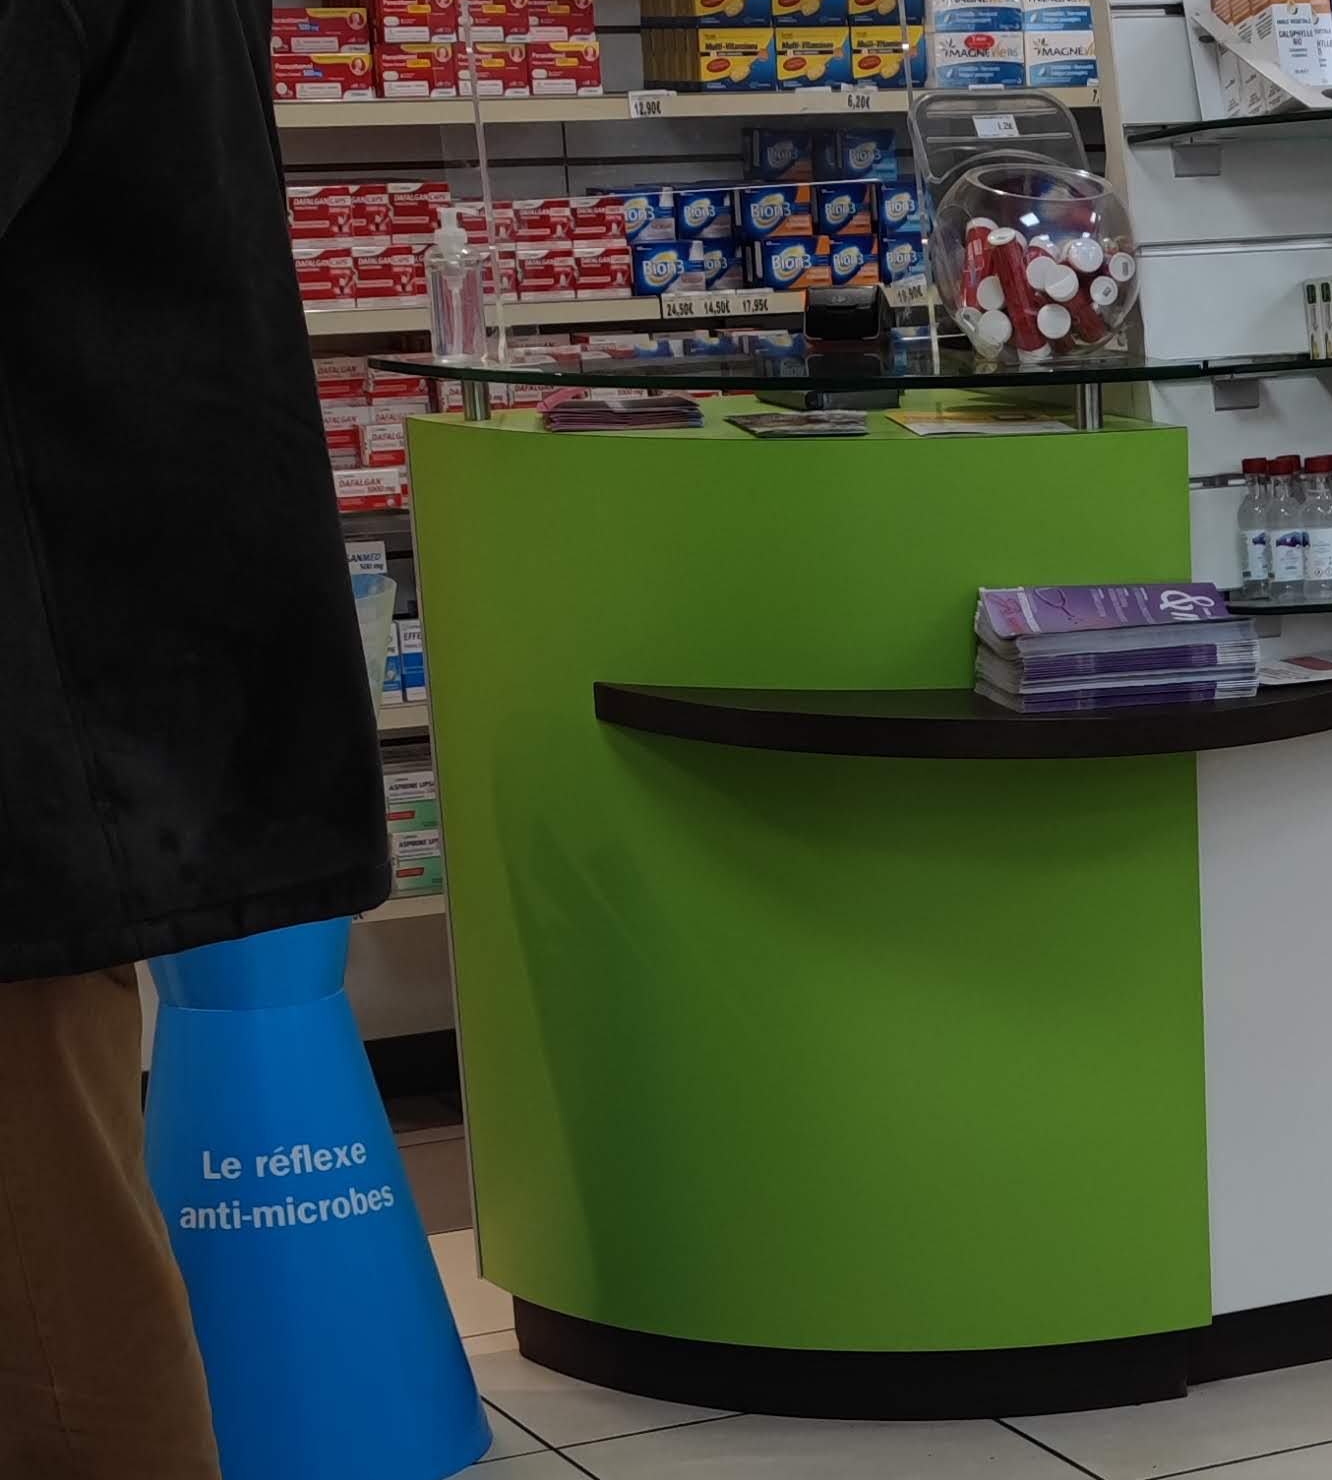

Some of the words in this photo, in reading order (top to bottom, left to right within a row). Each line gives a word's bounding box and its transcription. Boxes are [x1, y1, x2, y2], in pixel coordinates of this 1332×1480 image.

[634, 101, 662, 116] 12,90€
[847, 95, 871, 110] 6,20€
[665, 302, 694, 317] 24,50€
[703, 300, 731, 315] 14,50€
[742, 299, 769, 313] 17,95€
[202, 1150, 243, 1181] Le
[255, 1141, 368, 1179] réflexe
[180, 1183, 395, 1231] anti-microbes
